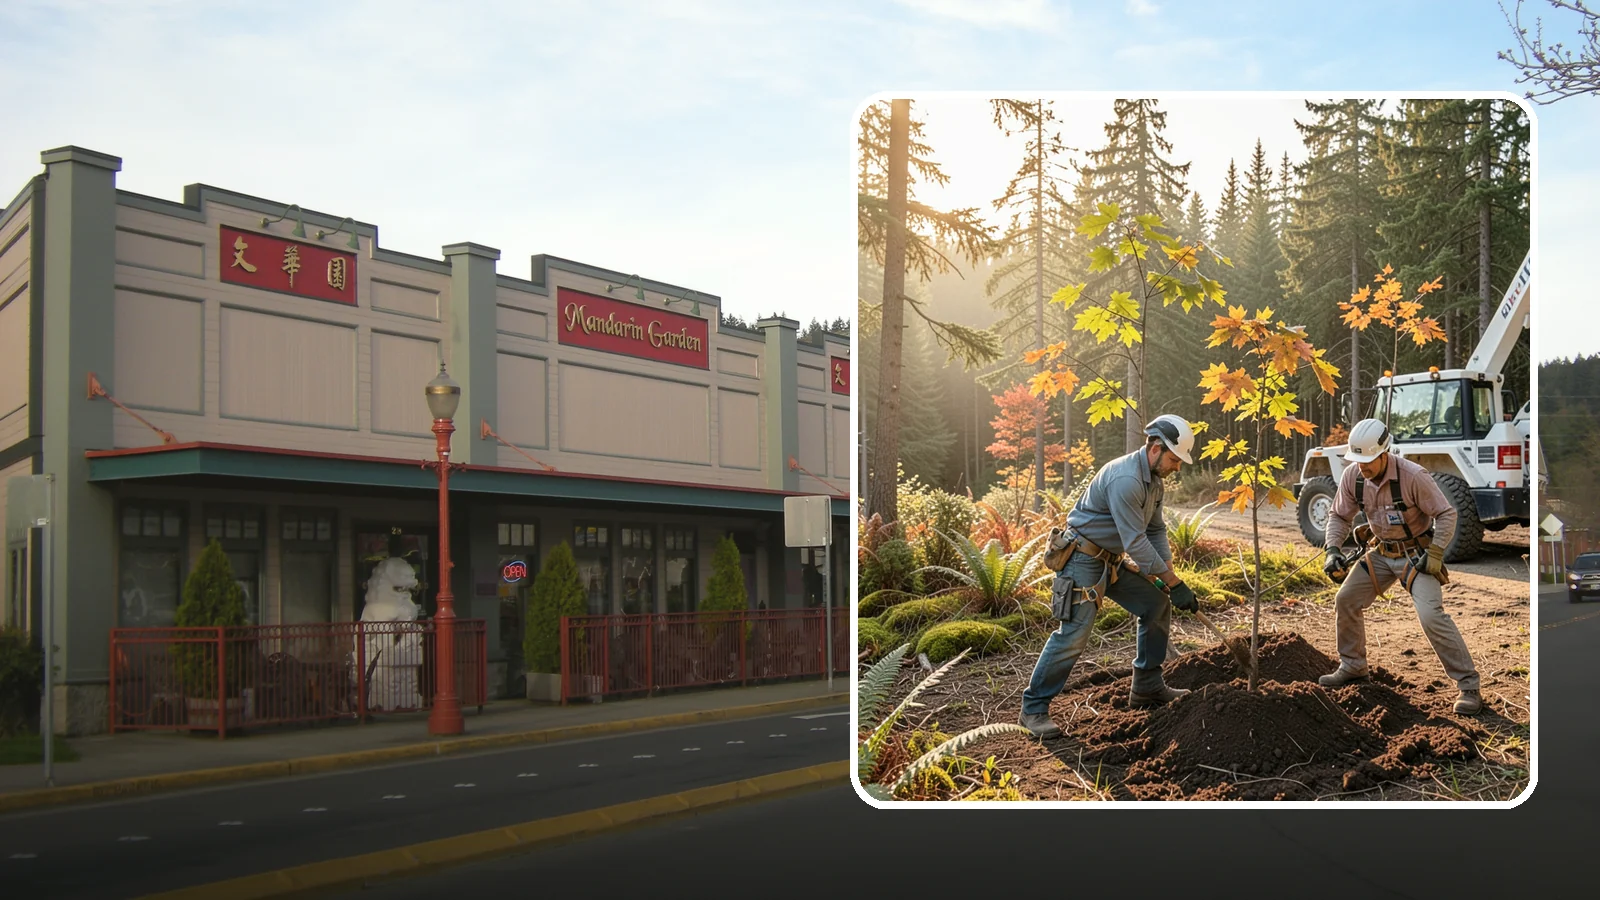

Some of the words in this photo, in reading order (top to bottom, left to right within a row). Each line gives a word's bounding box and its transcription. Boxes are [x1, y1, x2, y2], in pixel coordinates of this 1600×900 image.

[230, 235, 346, 291] 文華園
[564, 302, 644, 341] Mandarin
[647, 320, 701, 352] Garden
[503, 565, 527, 578] OPEN
